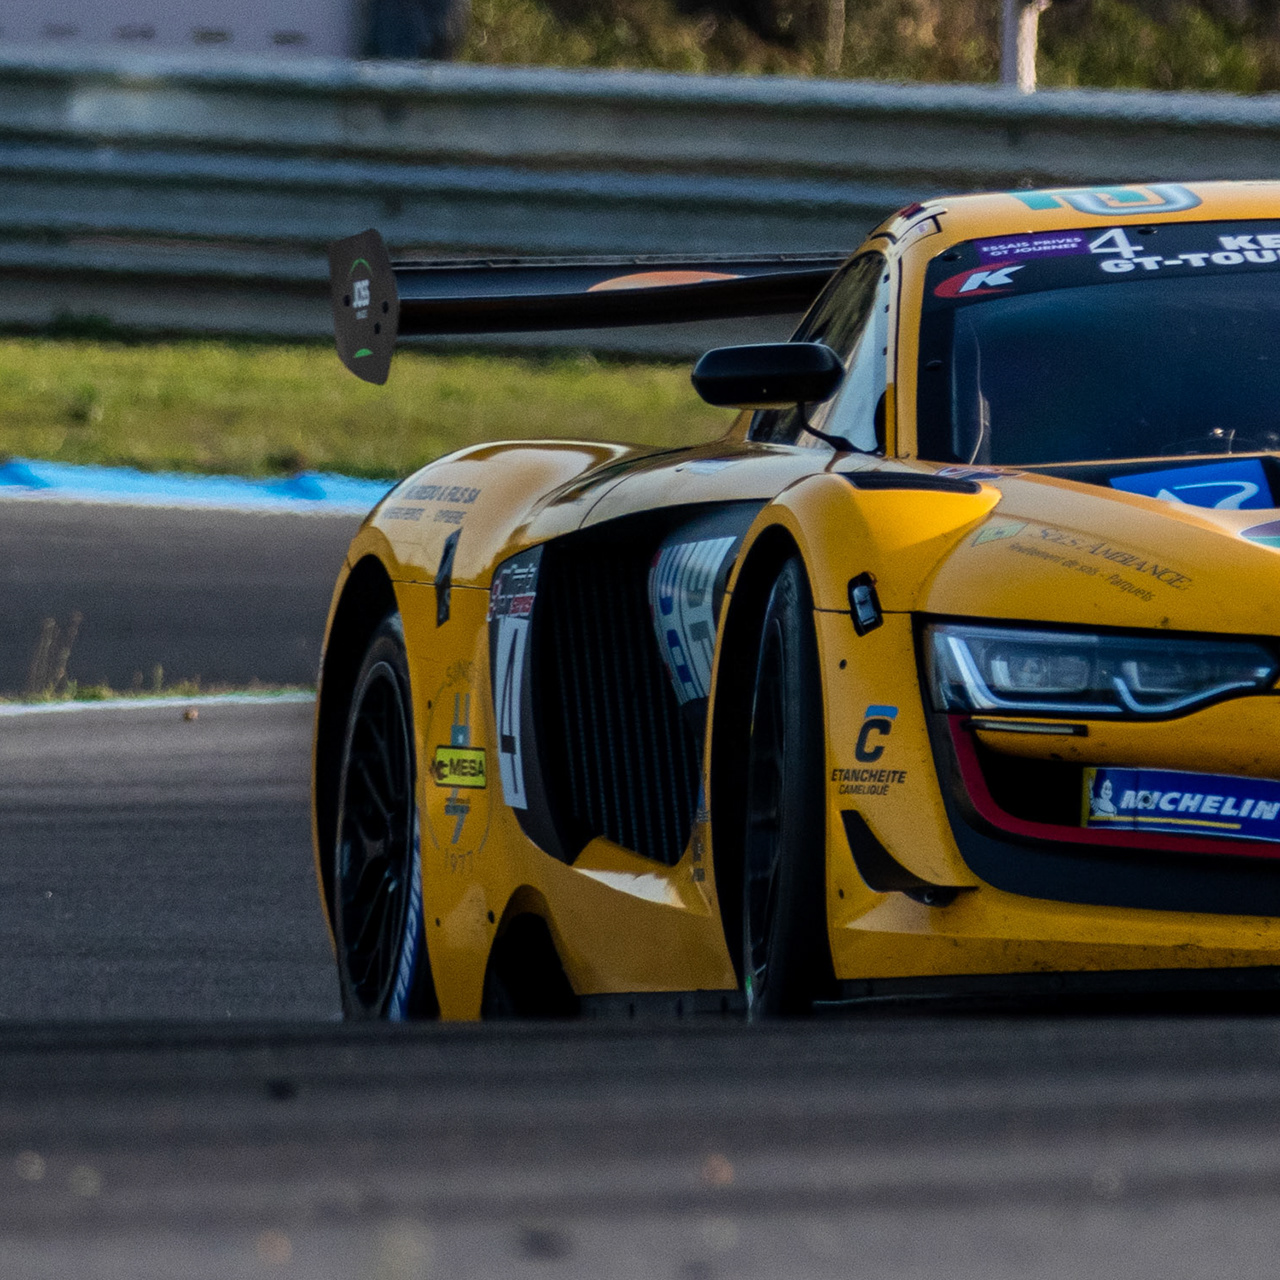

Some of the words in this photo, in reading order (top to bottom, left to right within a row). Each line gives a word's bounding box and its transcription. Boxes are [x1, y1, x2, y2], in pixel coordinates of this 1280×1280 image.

[982, 242, 1021, 253] ESSAIS
[990, 248, 1011, 258] GT
[1088, 227, 1144, 260] 4
[1106, 573, 1157, 603] Parquets
[855, 718, 892, 764] C
[449, 758, 485, 778] MESA
[830, 767, 908, 784] ETANCHEITE
